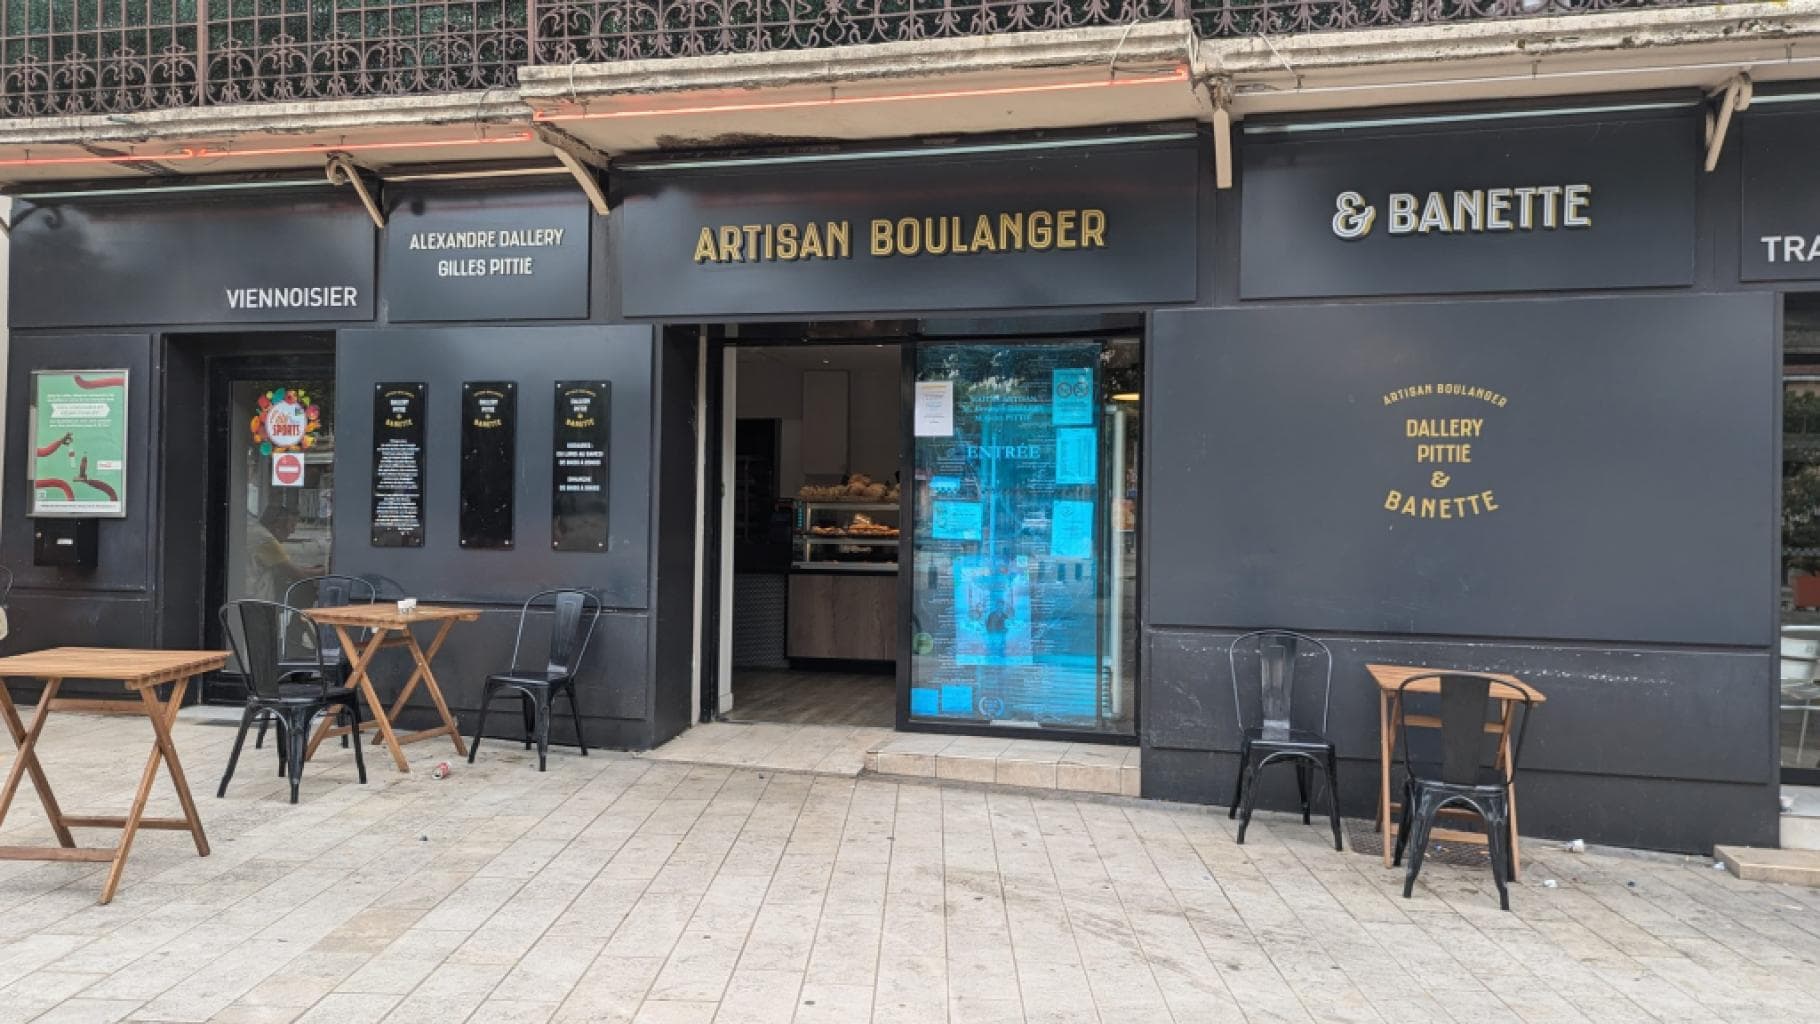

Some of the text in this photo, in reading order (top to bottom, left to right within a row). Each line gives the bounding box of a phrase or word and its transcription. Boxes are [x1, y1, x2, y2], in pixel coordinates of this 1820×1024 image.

[1332, 183, 1593, 240] & BANETTE
[409, 228, 565, 250] ALEXANDRE DALLERY
[693, 208, 1108, 262] ARTISAN BOULANGER
[438, 259, 486, 277] GILLES
[226, 286, 358, 310] VIENNOISIER
[1383, 383, 1508, 408] ARTISAN BOULANGER
[1406, 418, 1484, 438] DALLERY
[966, 442, 1041, 460] ENTRÉE
[1417, 444, 1472, 463] PITTIE
[1430, 470, 1451, 488] &
[1384, 490, 1500, 519] BANETTE
